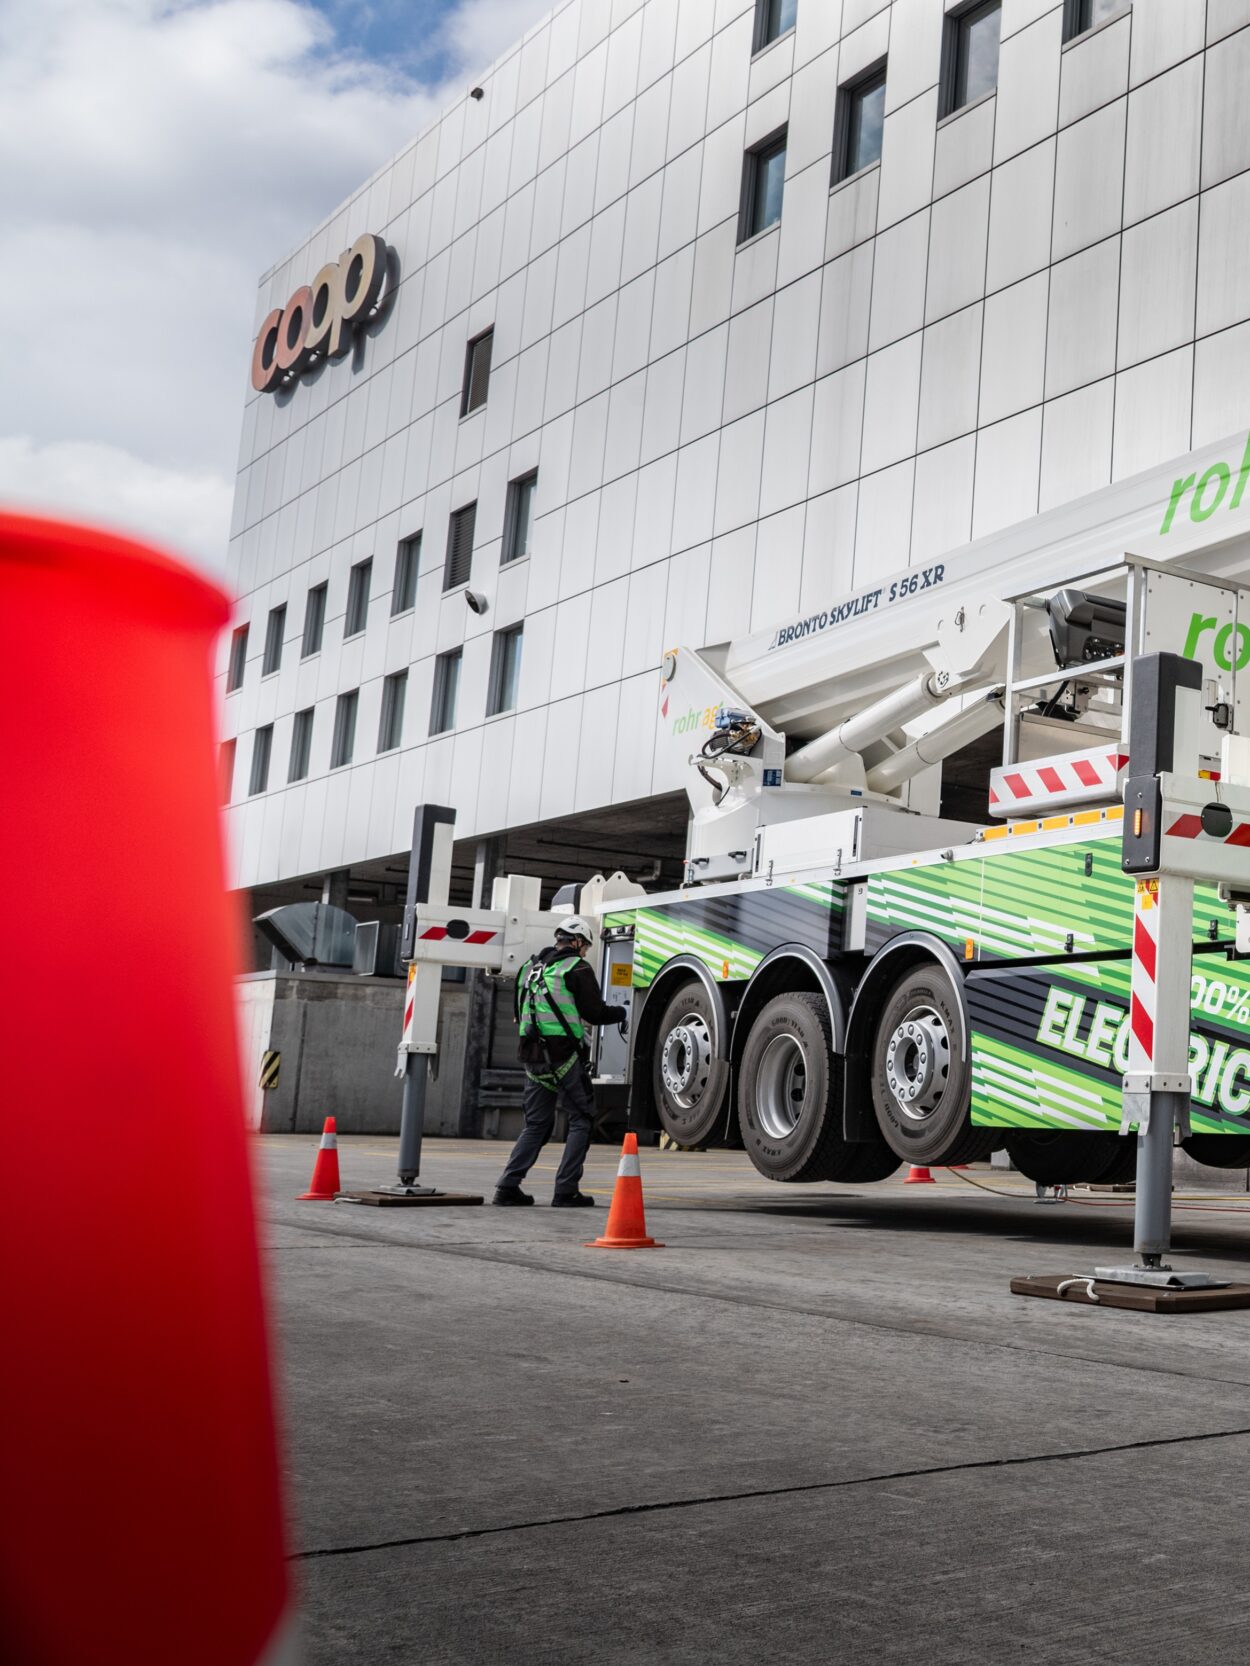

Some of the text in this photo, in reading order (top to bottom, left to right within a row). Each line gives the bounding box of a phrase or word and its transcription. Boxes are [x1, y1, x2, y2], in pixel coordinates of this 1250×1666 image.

[252, 233, 383, 392] coop
[778, 564, 945, 647] BRONTO SKYLIFT S 56 XR
